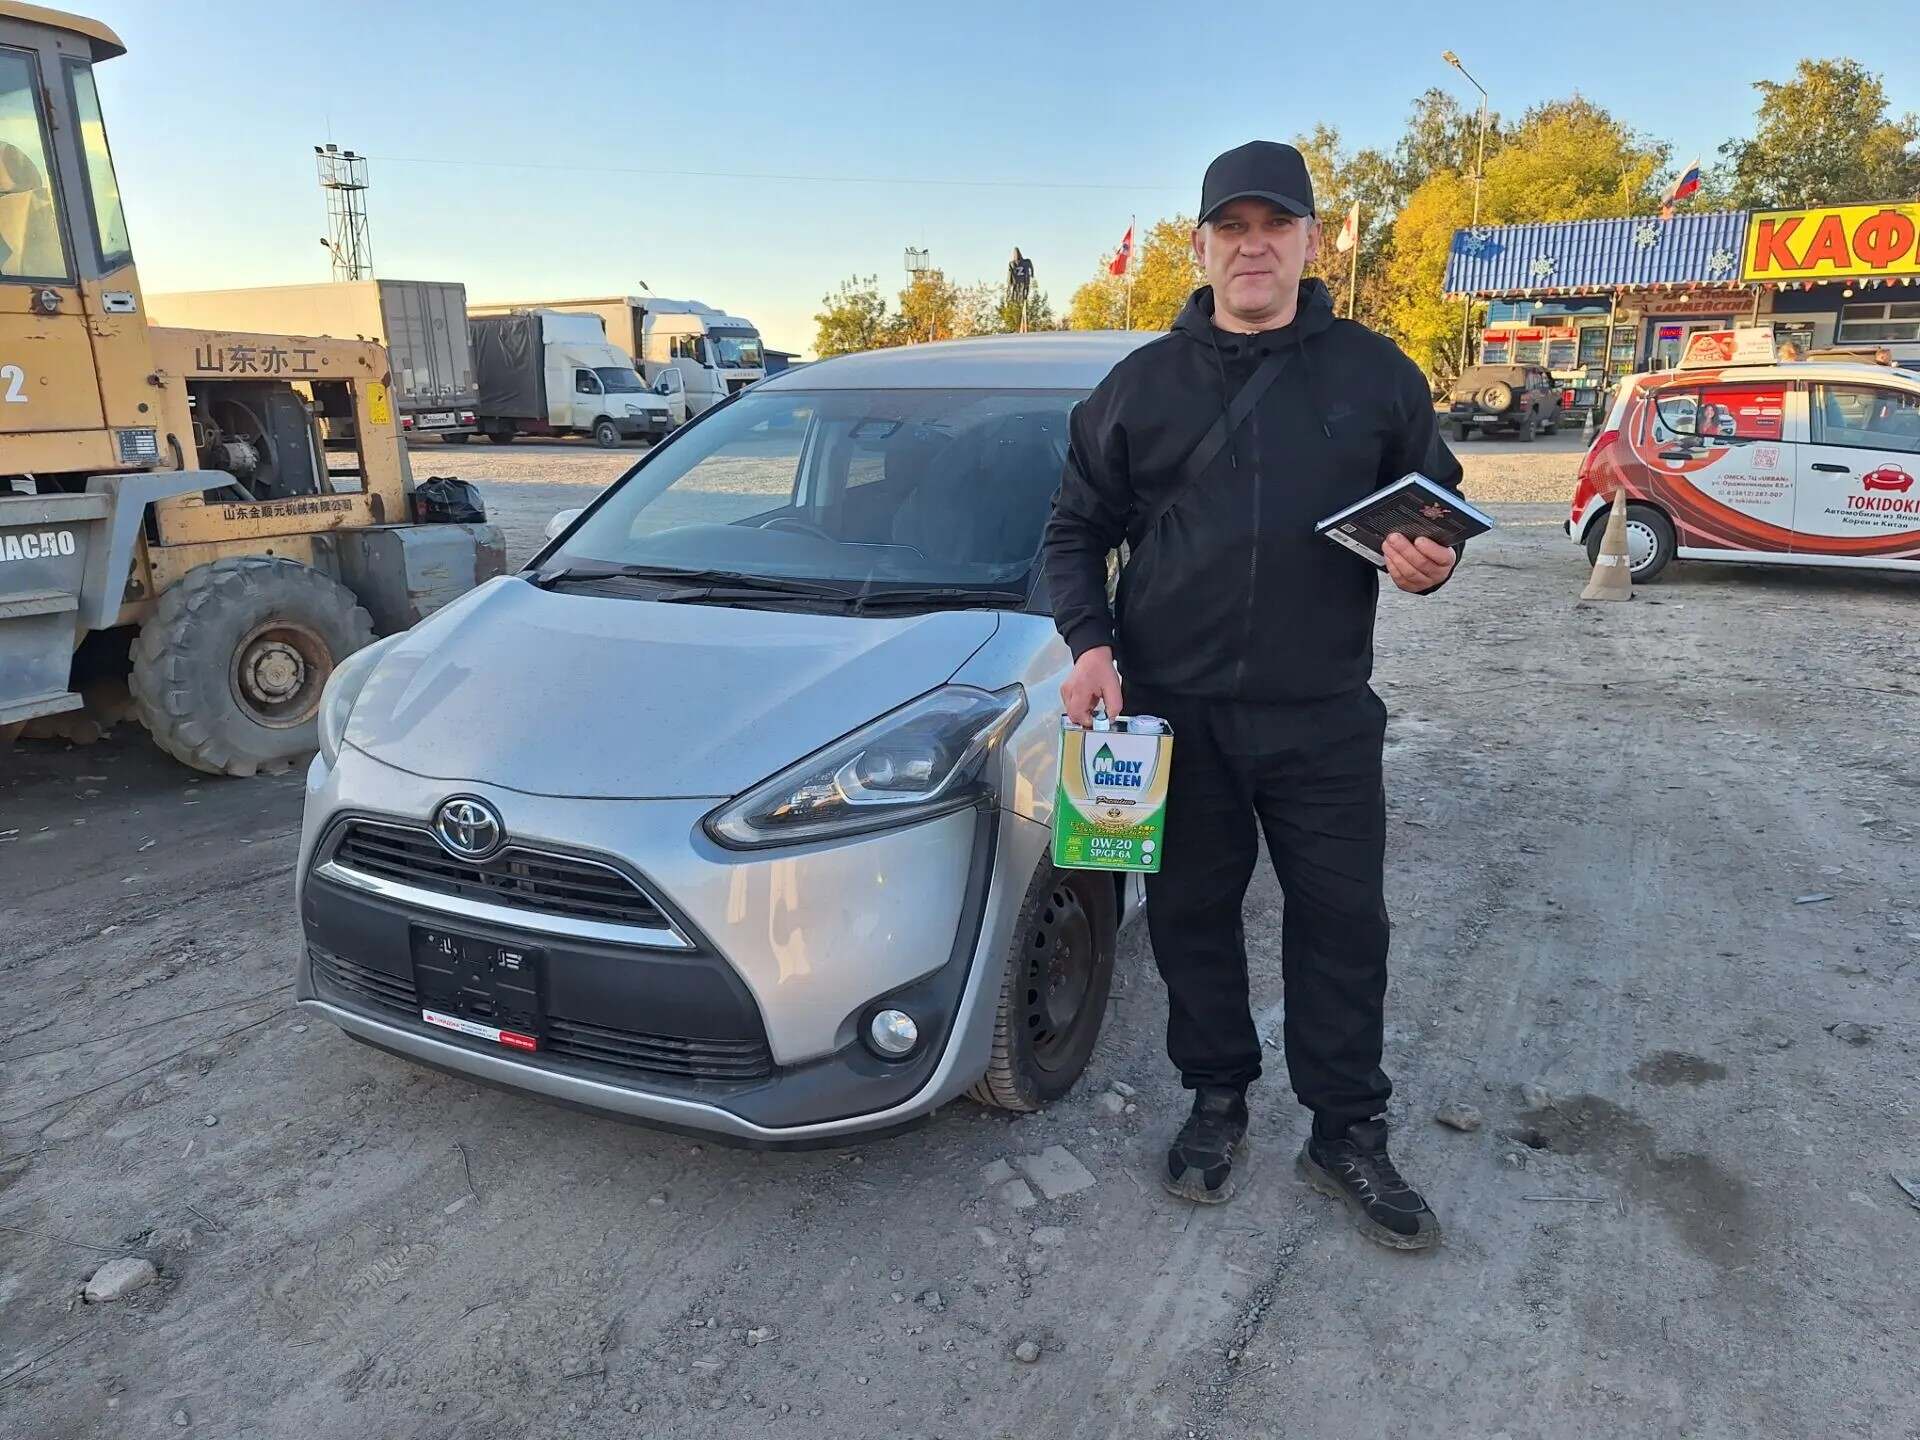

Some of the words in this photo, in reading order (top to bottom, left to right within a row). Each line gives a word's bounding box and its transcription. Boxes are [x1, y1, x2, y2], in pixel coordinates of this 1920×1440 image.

[1753, 209, 1920, 272] КАФ
[195, 344, 319, 374] 山东亦工
[1847, 495, 1920, 513] TOKIDOKI
[1095, 757, 1143, 773] MOLY
[1094, 773, 1141, 787] GREEN
